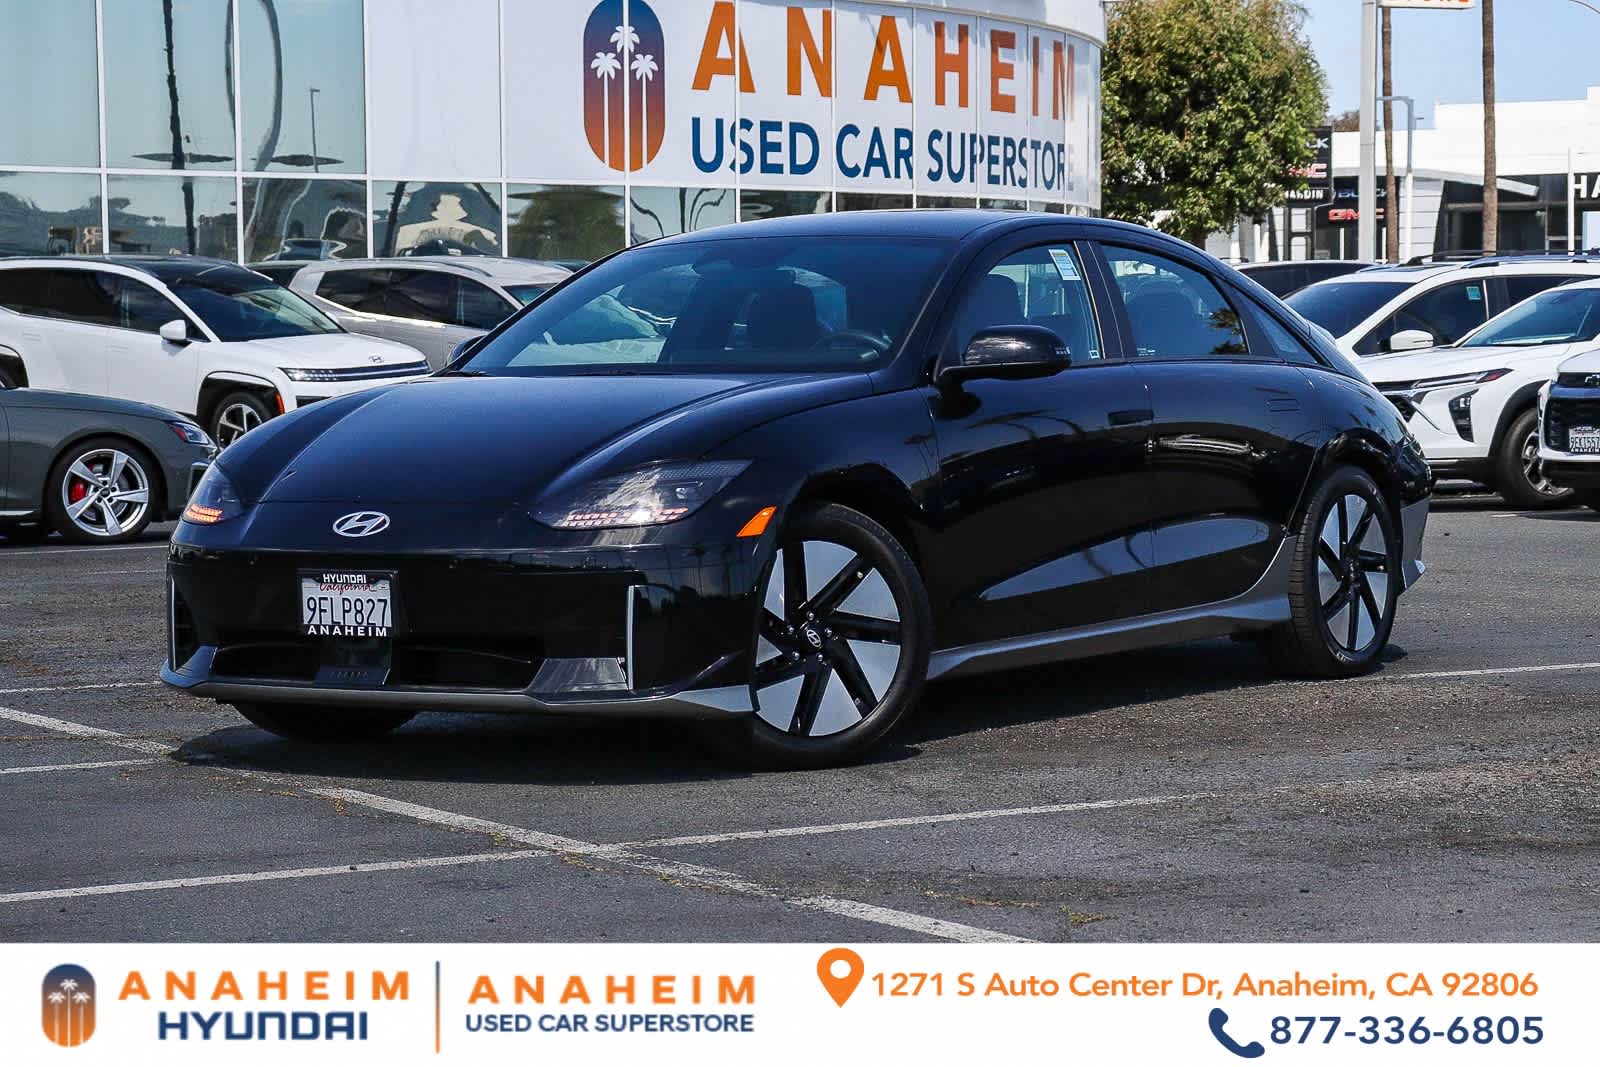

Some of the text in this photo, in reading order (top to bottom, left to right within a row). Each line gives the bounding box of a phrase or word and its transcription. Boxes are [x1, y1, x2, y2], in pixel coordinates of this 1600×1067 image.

[691, 1, 1075, 121] ANAHEIM
[692, 117, 1074, 192] USED CAR SUPERSTORE
[323, 574, 366, 583] HYUNDAI
[306, 596, 388, 627] 9FLP827
[307, 625, 387, 637] ANAHEIM
